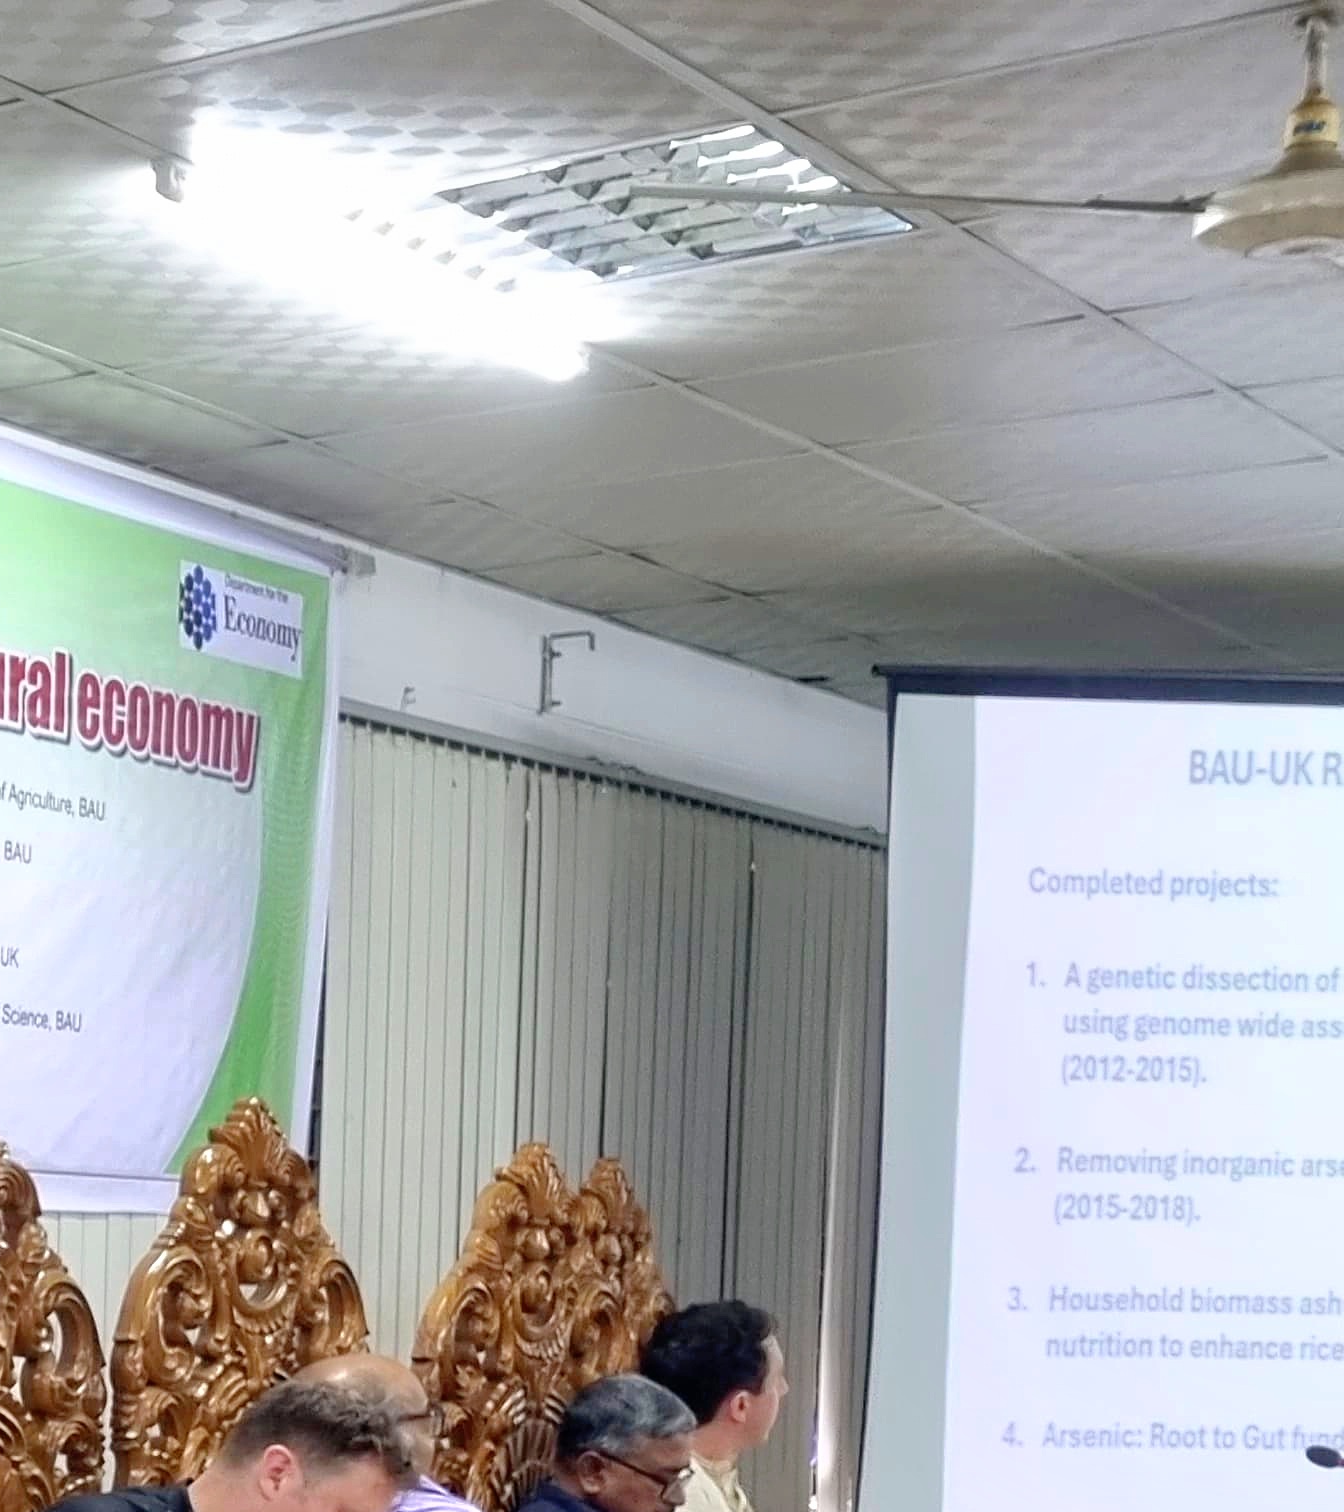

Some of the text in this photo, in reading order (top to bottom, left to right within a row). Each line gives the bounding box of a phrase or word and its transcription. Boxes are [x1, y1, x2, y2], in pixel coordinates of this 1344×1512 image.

[224, 594, 304, 662] Economy
[77, 670, 260, 786] economy
[1188, 750, 1313, 786] BAU-UK
[78, 797, 106, 821] BAU
[4, 840, 32, 864] BAU
[1028, 867, 1279, 902] Completed projects:
[0, 947, 19, 968] UK
[1026, 961, 1340, 994] 1. A genetic dissection of
[55, 1011, 82, 1033] BAU
[1064, 1009, 1128, 1041] using
[1134, 1016, 1230, 1042] genome
[1237, 1011, 1294, 1038] wide
[1061, 1054, 1207, 1088] (2012-2015).
[1013, 1147, 1037, 1174] 2.
[1057, 1146, 1177, 1180] Removing
[1182, 1150, 1294, 1182] inorganic
[1054, 1193, 1201, 1226] (2015-2018).
[1007, 1286, 1342, 1315] 3. Household biomass ash
[1046, 1333, 1344, 1361] nutrition to enhance rice
[1001, 1422, 1024, 1448] 4.
[1042, 1422, 1143, 1450] Arsenic:
[1150, 1423, 1207, 1450] Root
[1213, 1427, 1235, 1450] to
[1243, 1425, 1285, 1451] Gut
